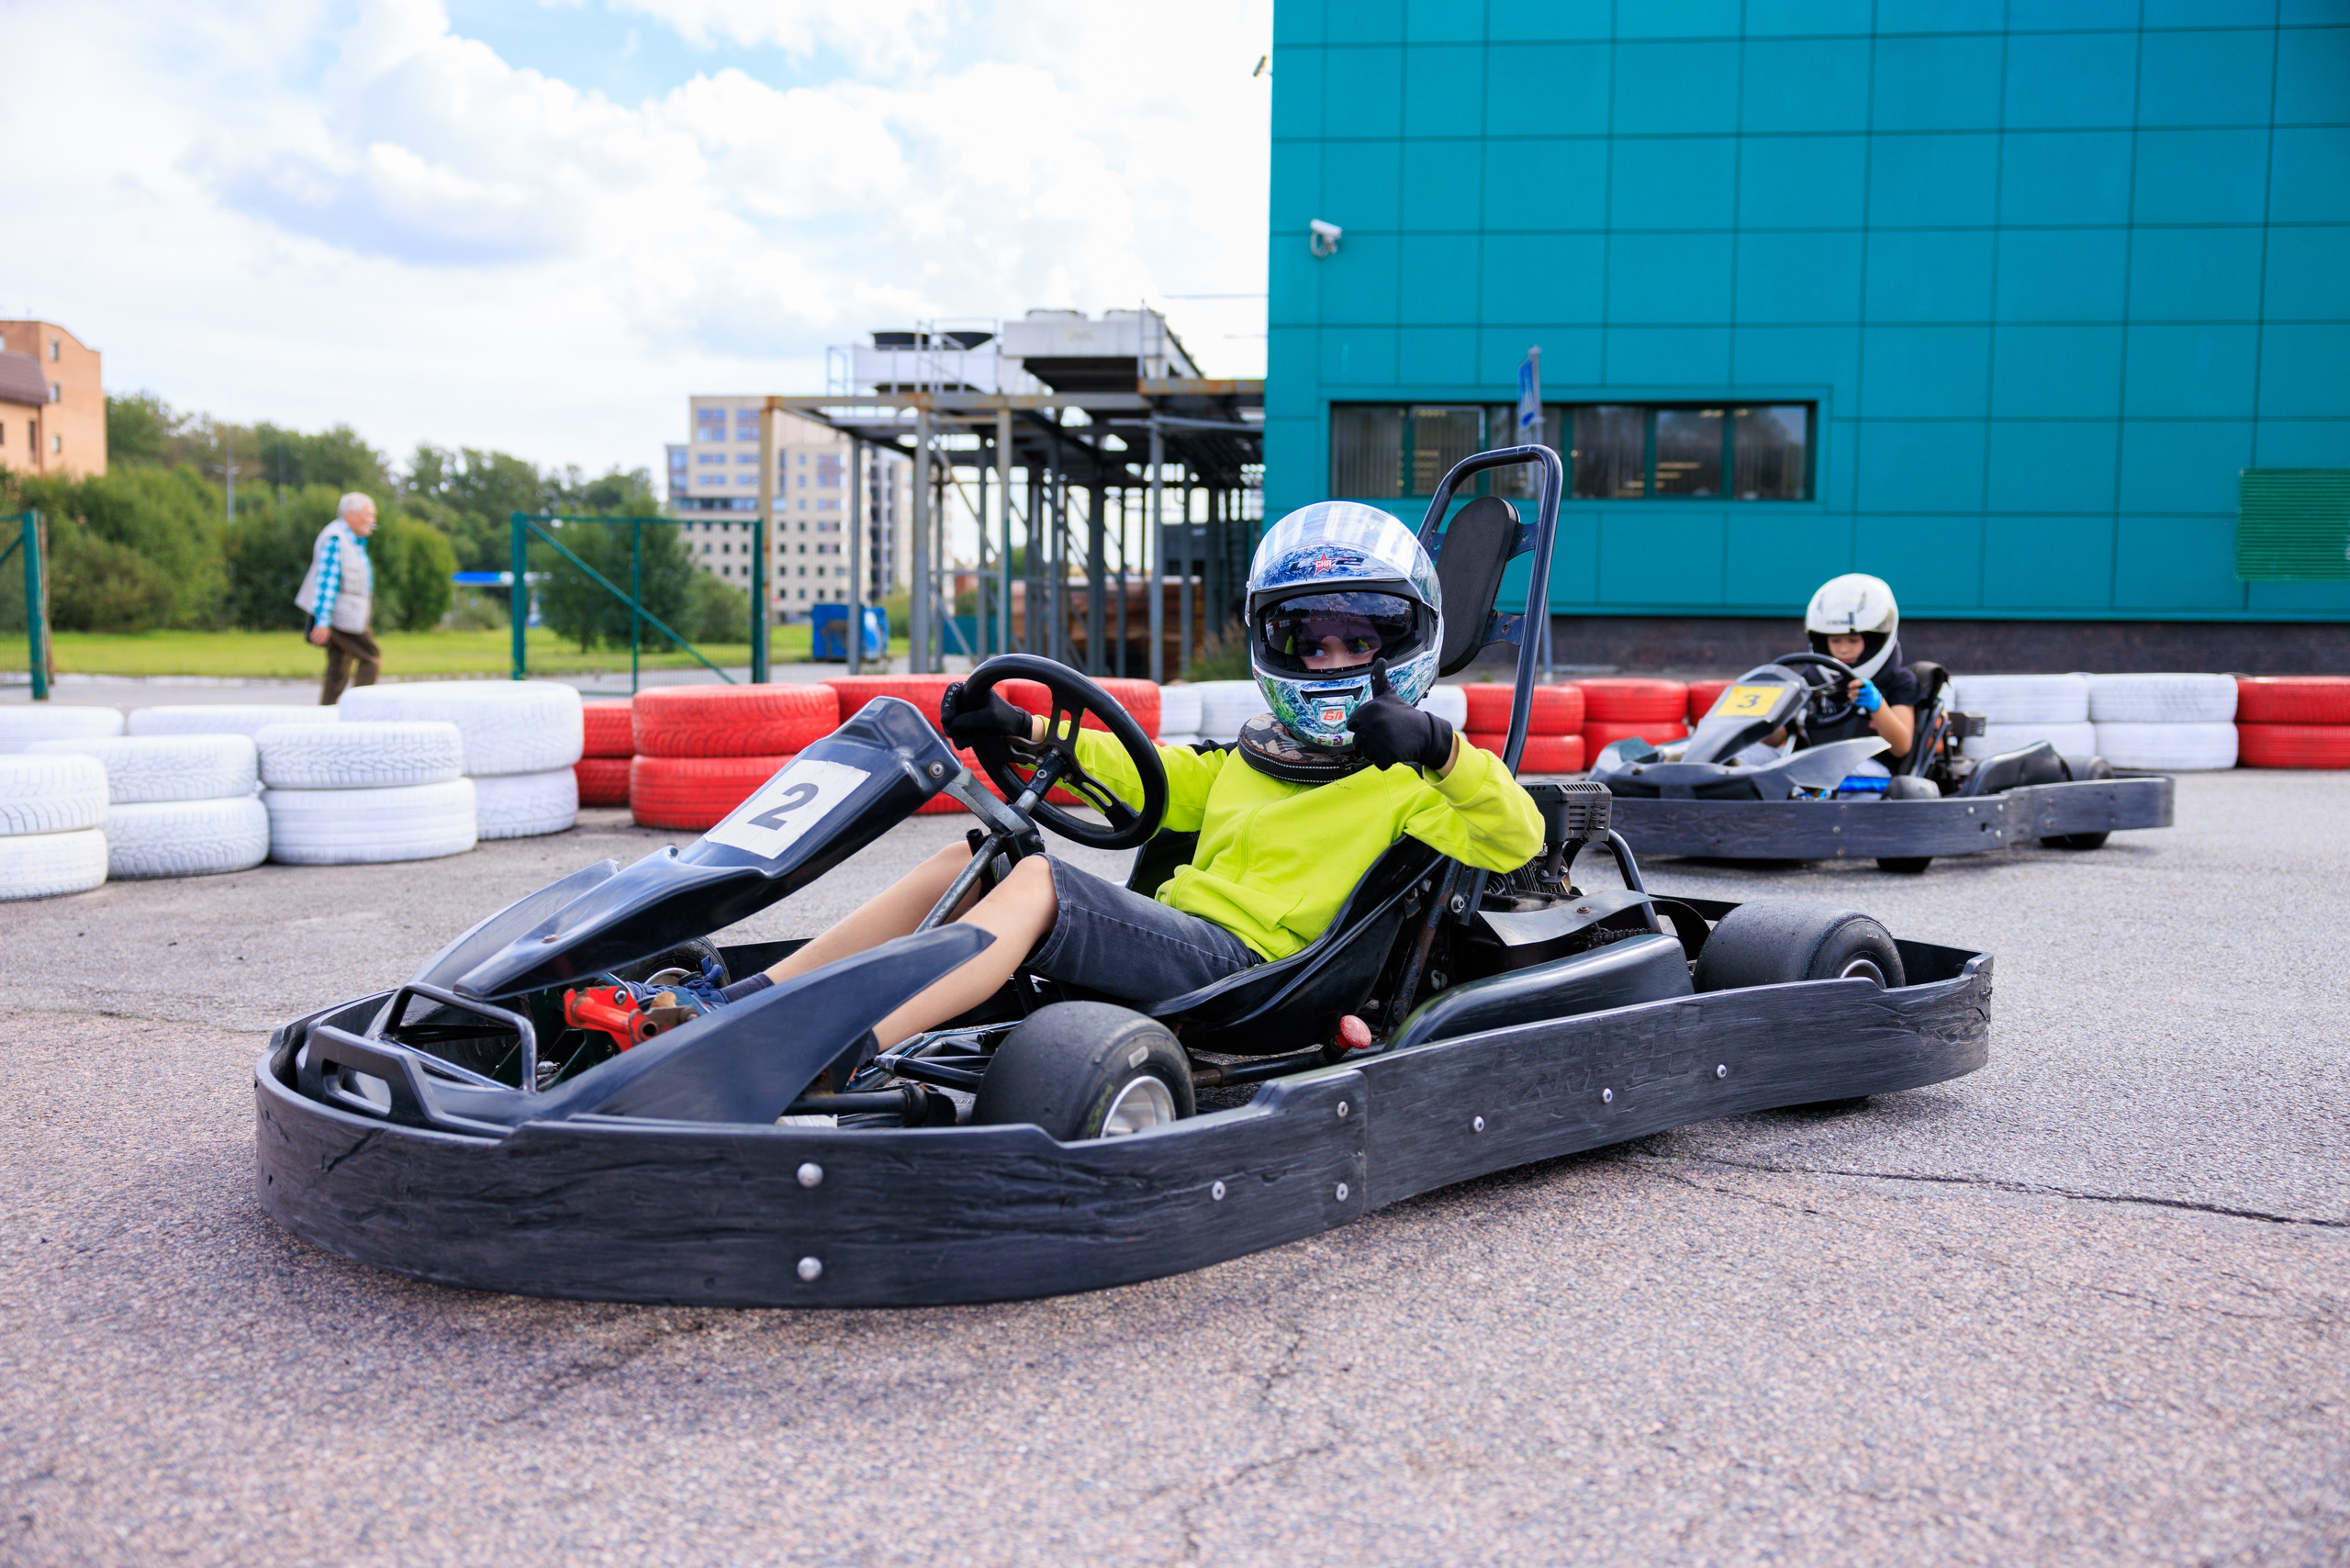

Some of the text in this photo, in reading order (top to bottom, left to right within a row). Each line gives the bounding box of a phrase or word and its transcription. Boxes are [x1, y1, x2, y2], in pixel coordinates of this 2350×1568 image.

[1737, 694, 1761, 709] 3
[747, 783, 819, 831] 2
[1489, 1063, 1611, 1112] KART
